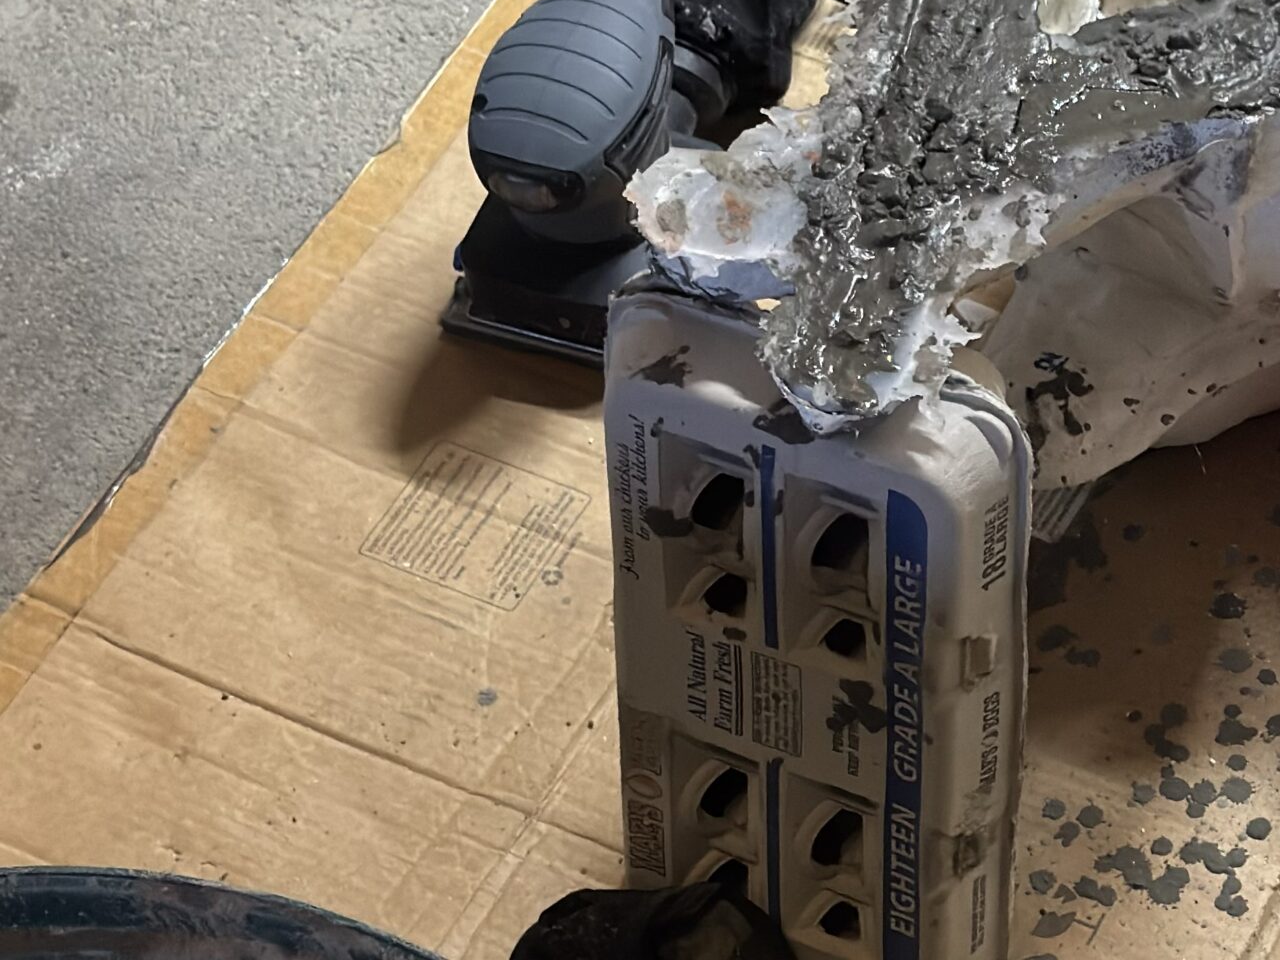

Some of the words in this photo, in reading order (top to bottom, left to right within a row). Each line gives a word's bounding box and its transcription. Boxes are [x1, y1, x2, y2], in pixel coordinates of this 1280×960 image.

[614, 442, 633, 505] chickens
[621, 507, 634, 534] our
[984, 501, 998, 516] A
[995, 493, 1009, 557] LARGE
[636, 527, 650, 542] to
[982, 516, 996, 565] GRADE
[981, 555, 1007, 591] 18
[893, 555, 922, 657] LARGE
[685, 629, 708, 695] Natural
[711, 640, 733, 685] Fresh
[893, 661, 919, 686] A
[687, 694, 708, 723] All
[713, 688, 733, 735] Farm
[893, 683, 919, 783] GRADE
[890, 802, 917, 939] EIGHTEEN
